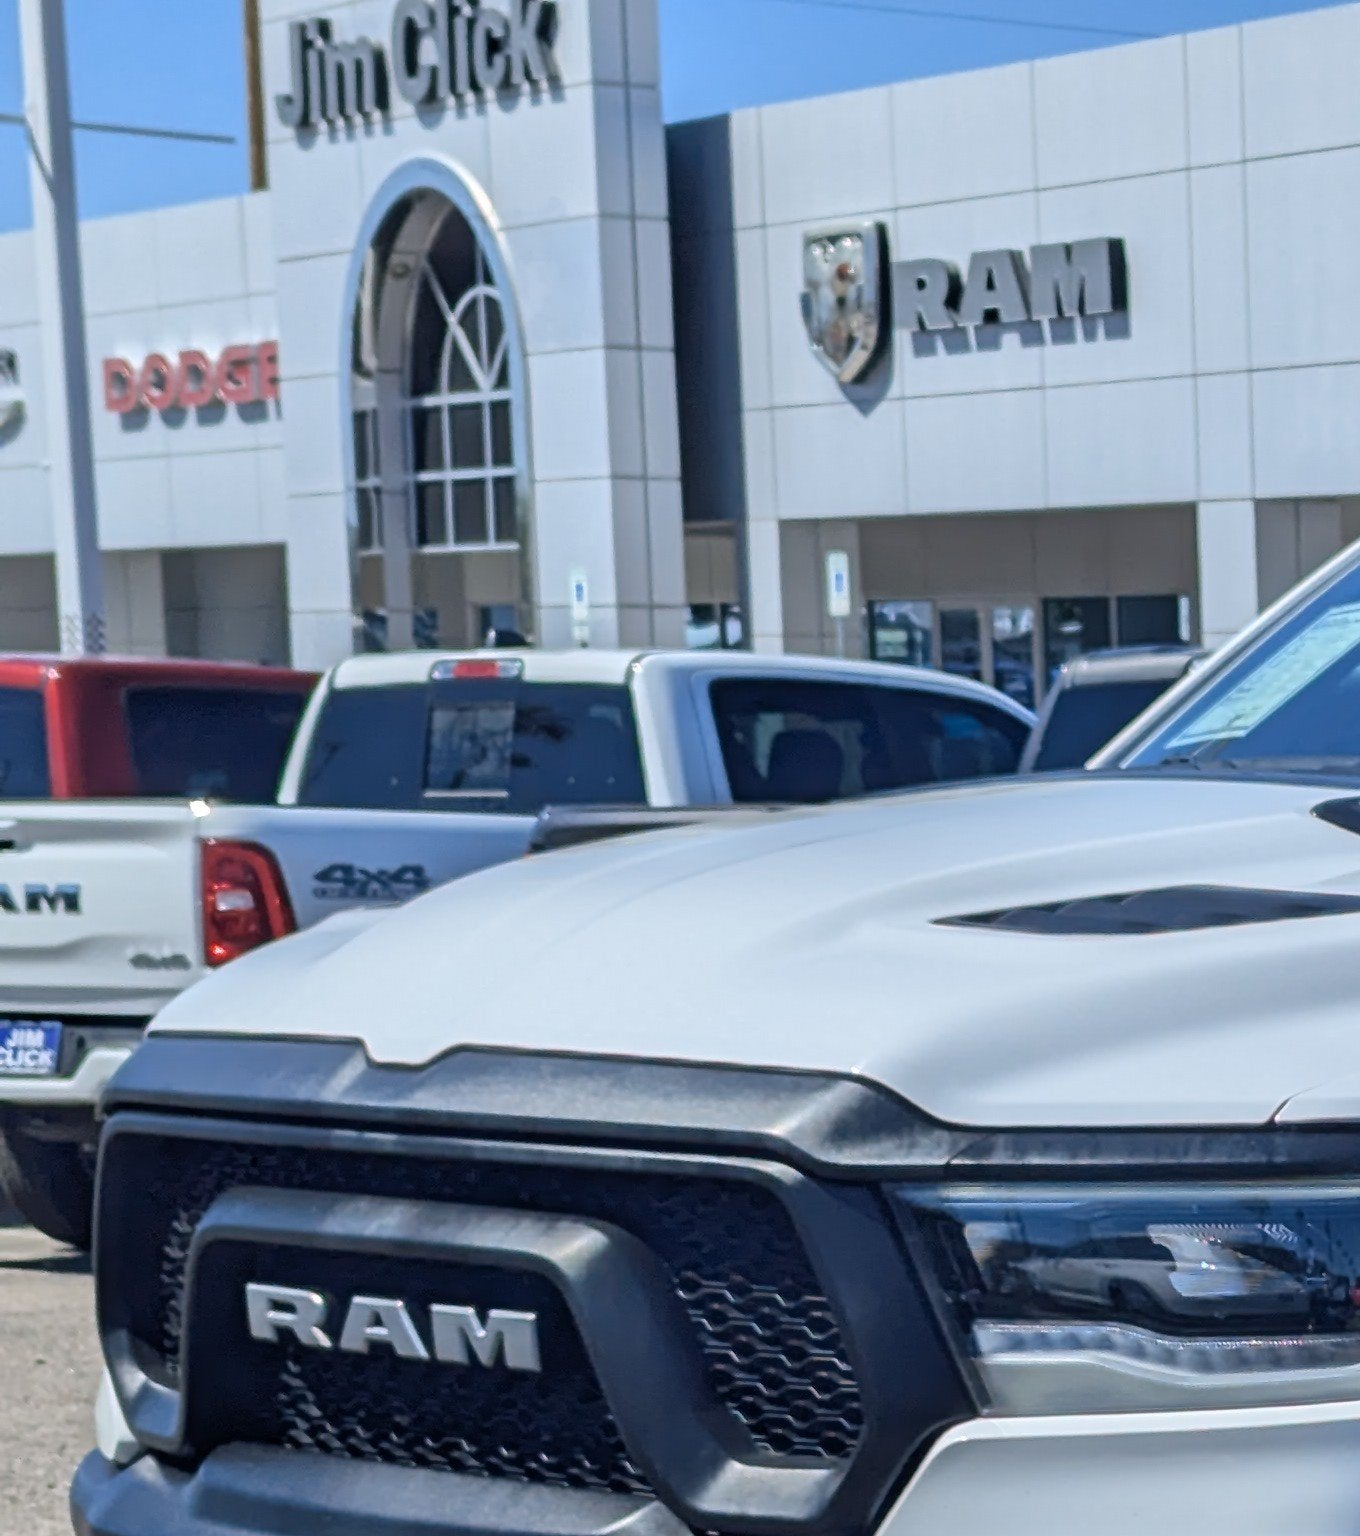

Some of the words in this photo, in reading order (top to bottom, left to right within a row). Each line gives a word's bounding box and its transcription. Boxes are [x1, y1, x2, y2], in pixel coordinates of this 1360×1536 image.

[275, 18, 386, 127] Jim
[391, 0, 556, 105] Click
[892, 237, 1124, 329] RAM
[103, 340, 279, 413] DODGE
[4, 1029, 44, 1048] JIM
[246, 1282, 541, 1373] RAM
